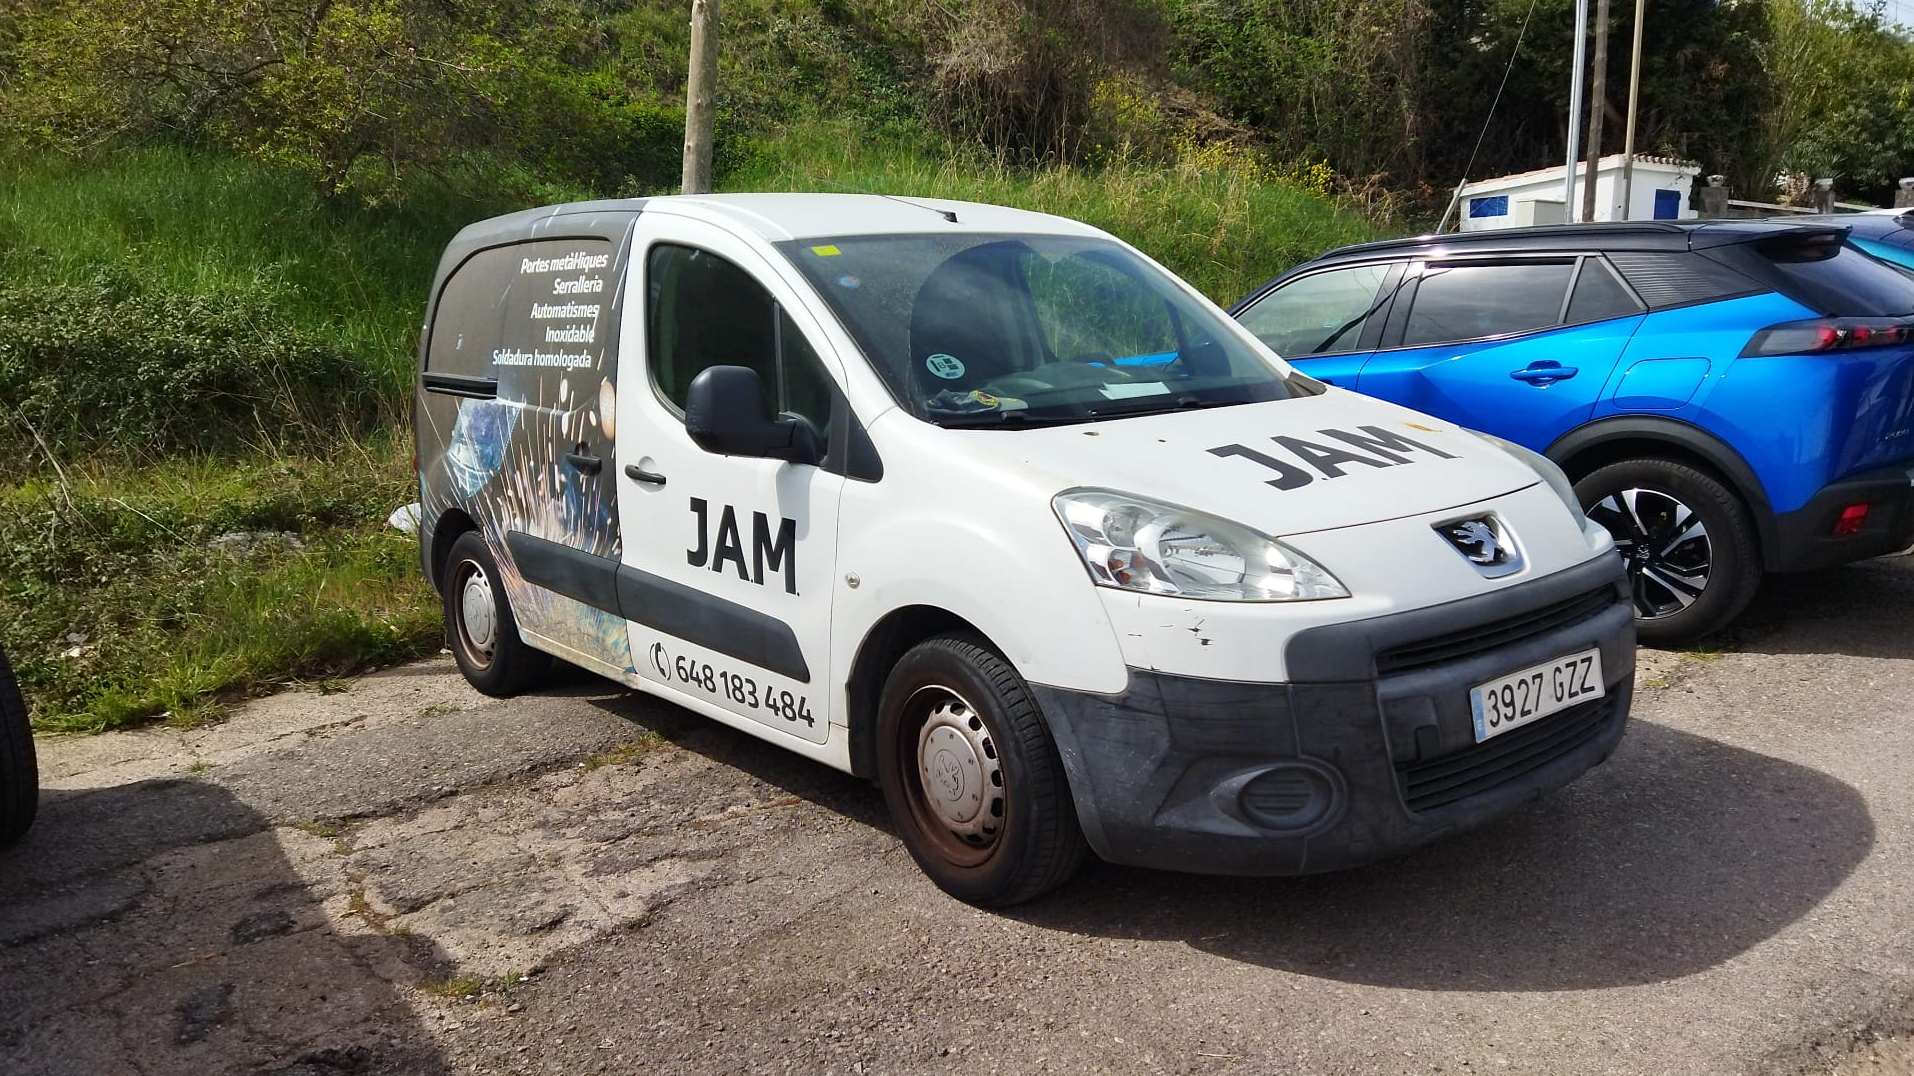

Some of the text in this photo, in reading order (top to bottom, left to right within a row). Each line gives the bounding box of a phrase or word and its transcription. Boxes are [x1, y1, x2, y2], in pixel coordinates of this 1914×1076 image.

[520, 257, 549, 274] Portes
[552, 274, 603, 295] Serralleria
[530, 301, 600, 319] Automatismes
[545, 324, 595, 343] Inoxidable
[492, 349, 592, 371] Soldadura homologada
[675, 655, 815, 728] 648 183 484
[1487, 656, 1596, 728] 3927 GZZ
